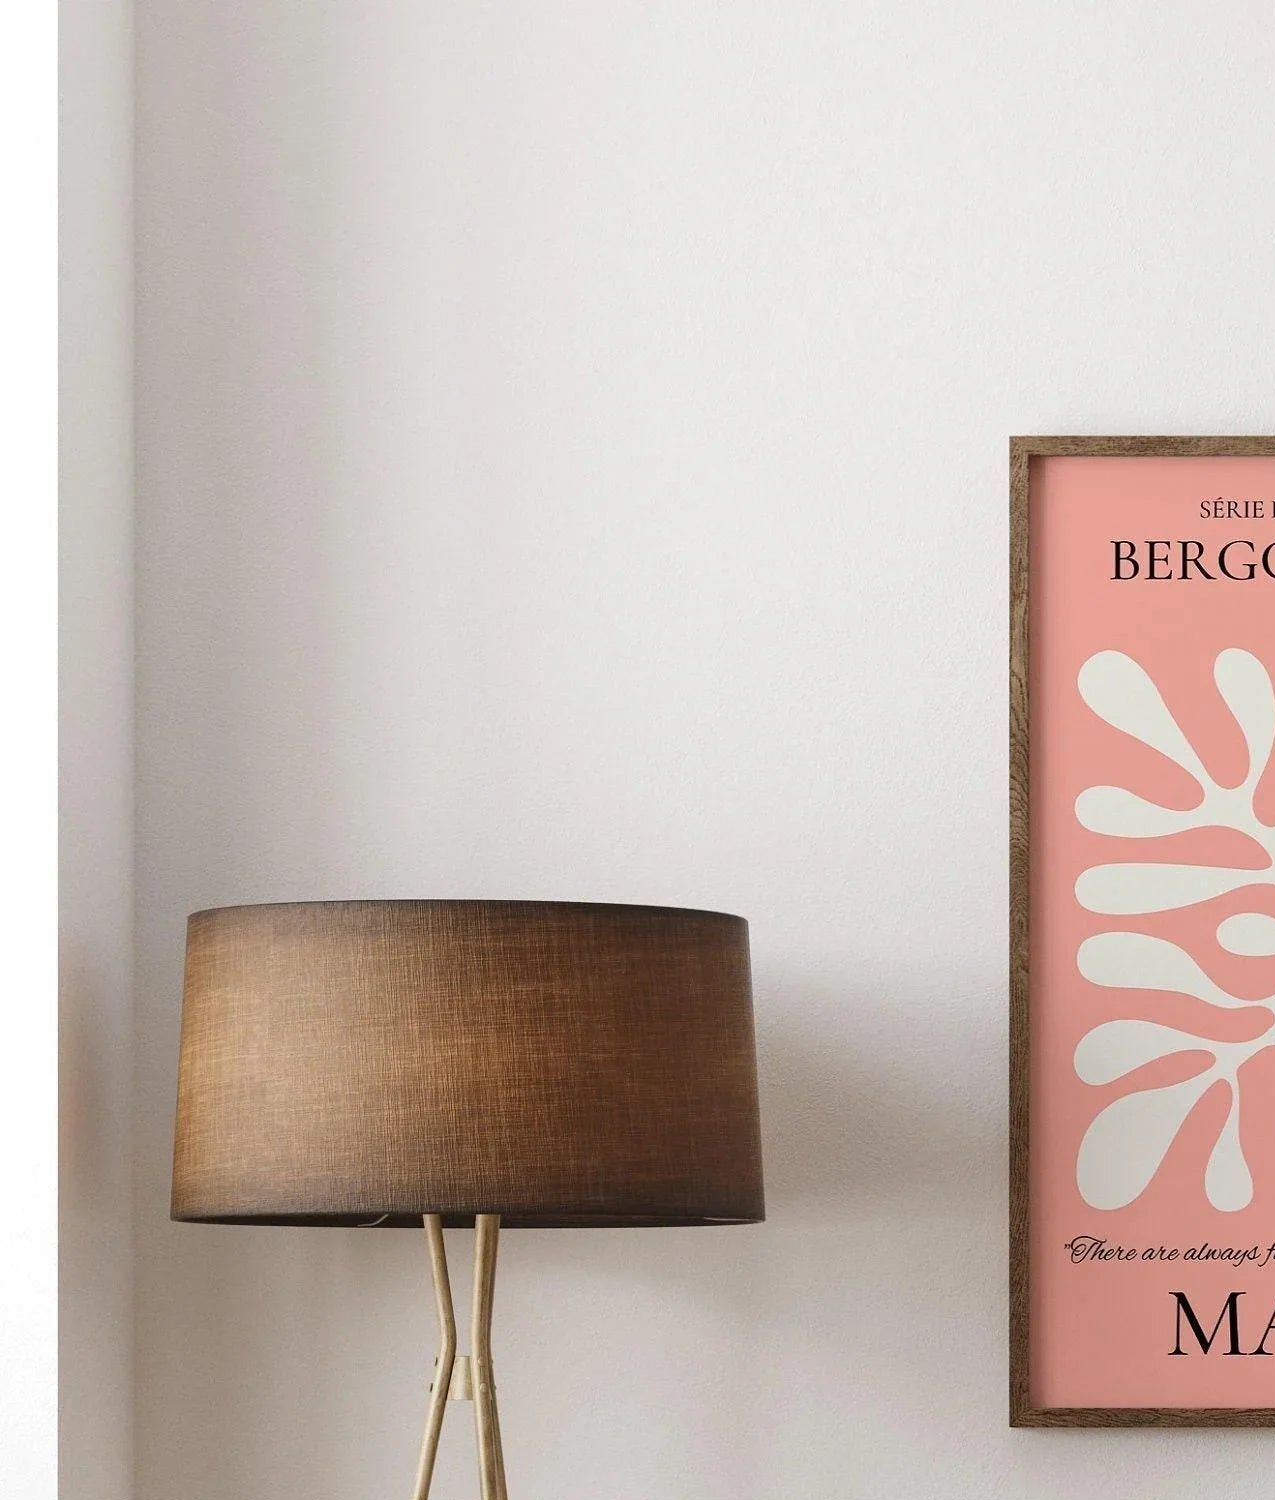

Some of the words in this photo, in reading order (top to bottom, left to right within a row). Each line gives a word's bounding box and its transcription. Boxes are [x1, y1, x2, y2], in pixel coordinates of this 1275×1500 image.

[1199, 496, 1265, 519] SÉRIE
[1141, 1246, 1181, 1261] are
[1183, 1242, 1262, 1267] always
